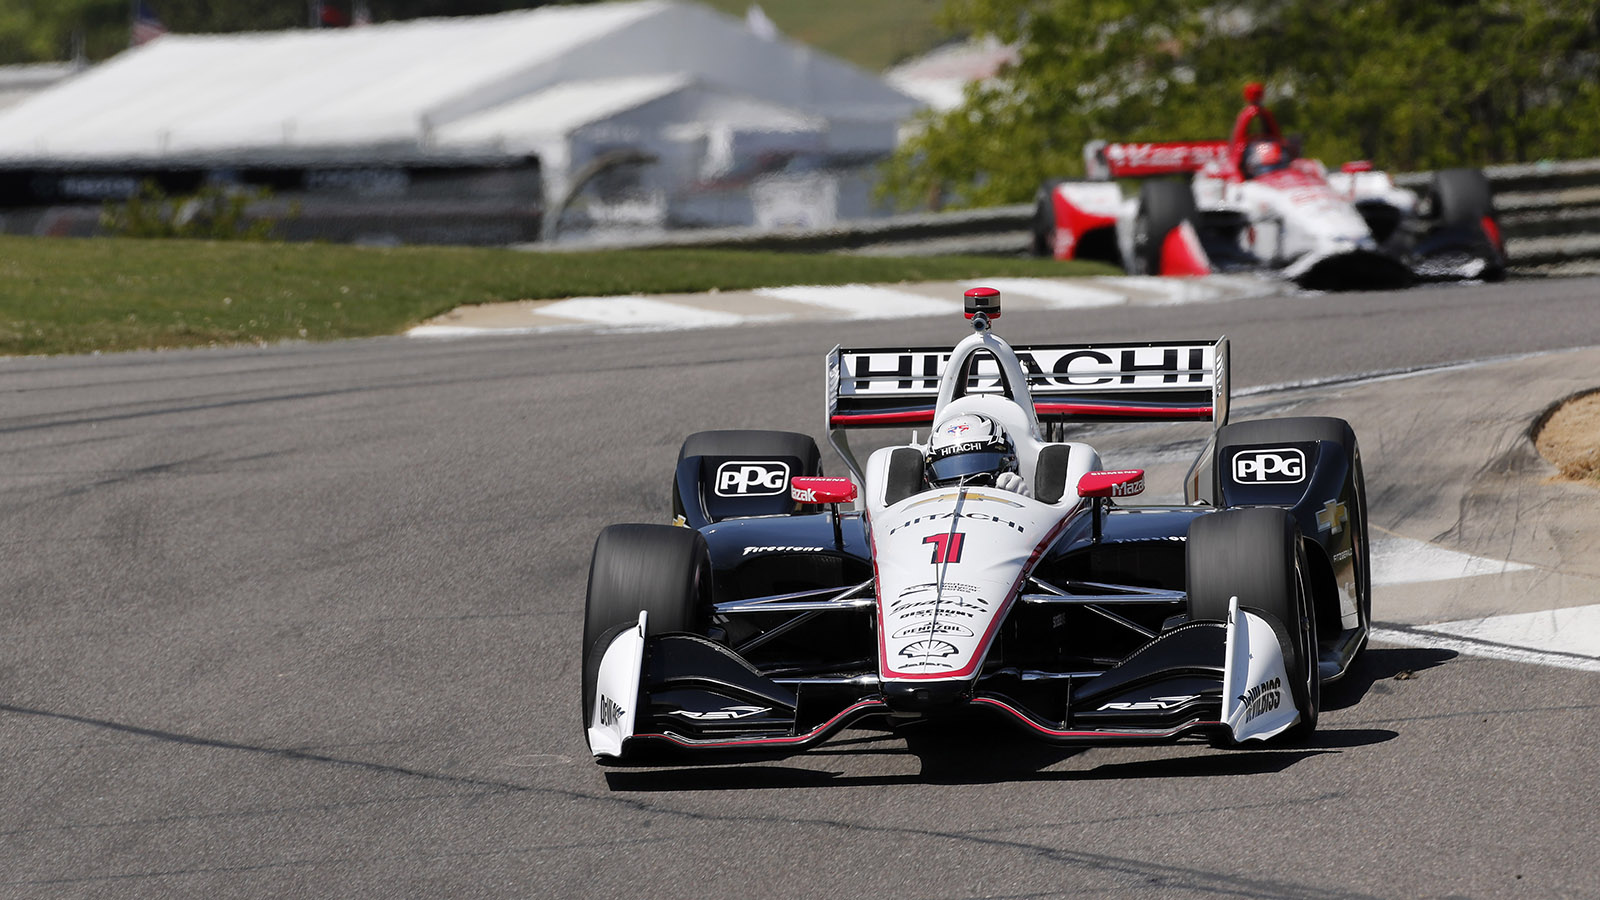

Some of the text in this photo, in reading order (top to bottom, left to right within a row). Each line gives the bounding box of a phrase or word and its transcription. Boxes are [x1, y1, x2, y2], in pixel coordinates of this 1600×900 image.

[856, 348, 1203, 389] HITACHI
[941, 442, 982, 456] HITACHI
[1237, 454, 1301, 481] PPG
[720, 466, 785, 493] PPG
[1111, 481, 1143, 496] Maza
[791, 487, 817, 502] azak
[889, 512, 1025, 536] HITACHI
[742, 546, 824, 556] Firestone
[922, 532, 966, 565] 1
[903, 625, 961, 636] PENNZOIL
